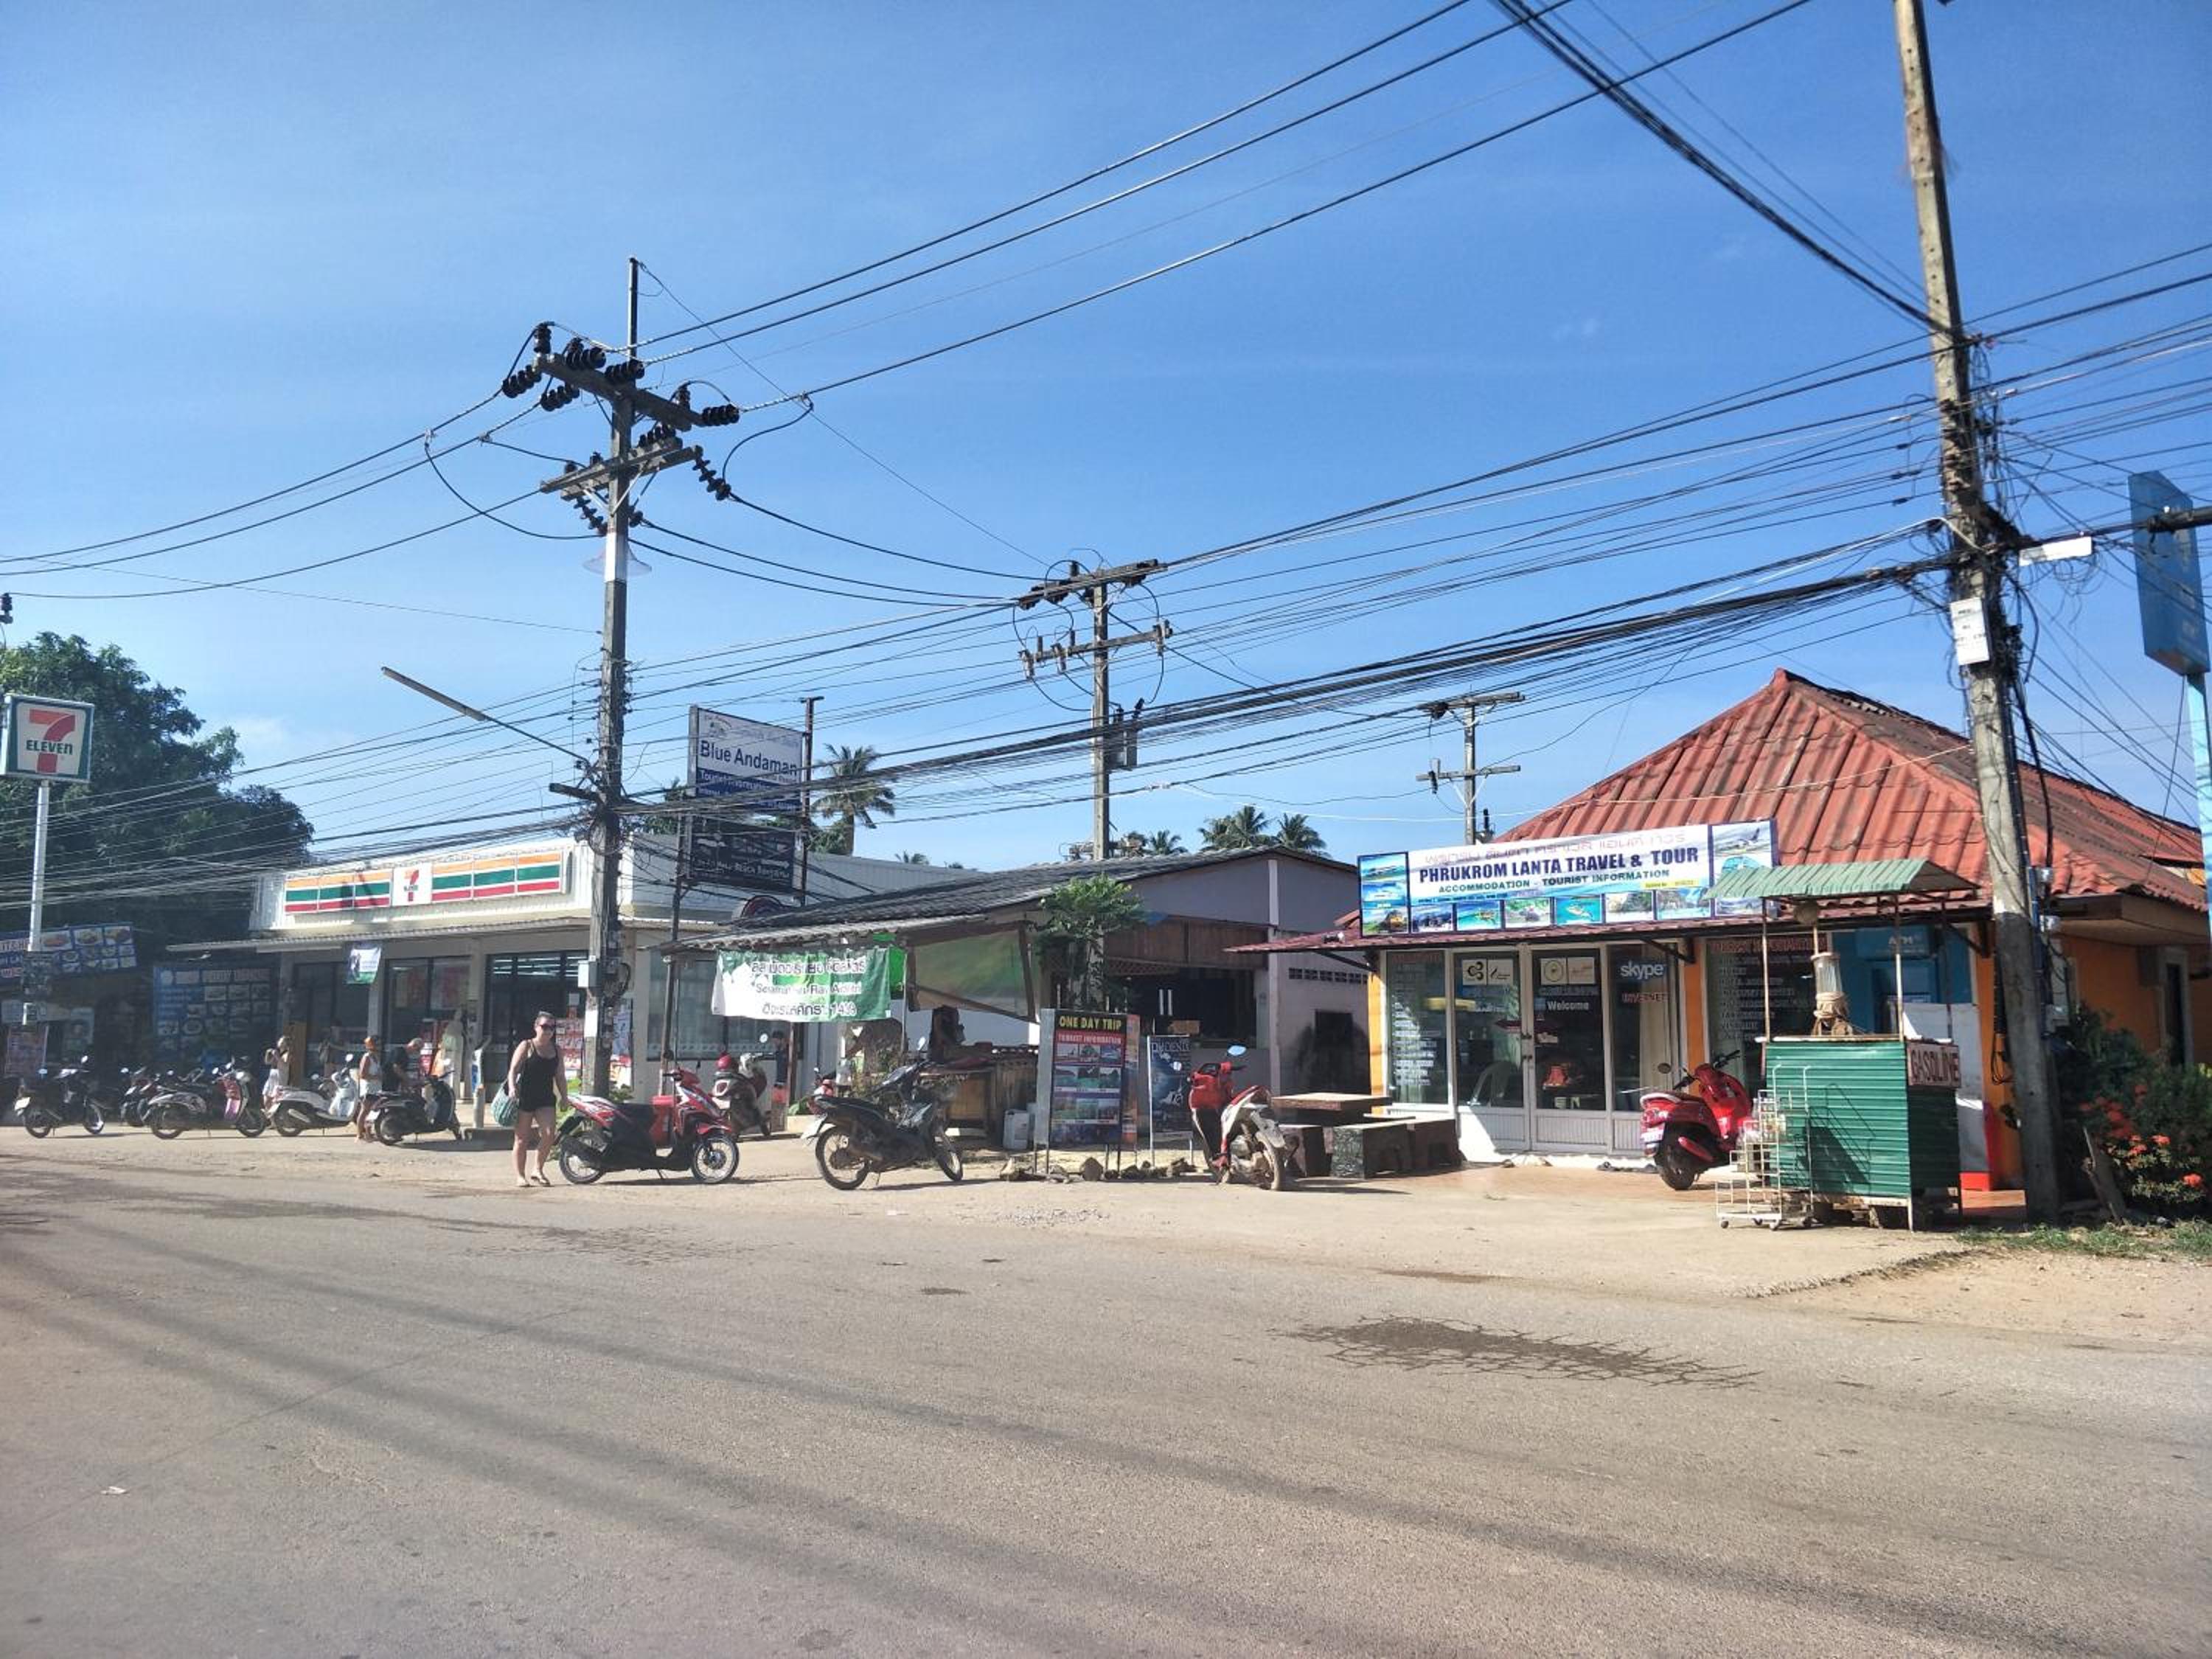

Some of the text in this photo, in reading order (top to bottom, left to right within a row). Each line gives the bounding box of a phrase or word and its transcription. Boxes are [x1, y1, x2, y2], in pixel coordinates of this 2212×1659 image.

[701, 740, 797, 776] Blue Andaman
[1419, 846, 1699, 883] PHRUKROM LANTA TRAVEL & TOUR
[1439, 879, 1530, 894] ACCOMMODATION
[1542, 874, 1588, 886] TOURIST
[1592, 869, 1670, 883] INFORMATION
[1620, 961, 1664, 980] skype
[1547, 1000, 1590, 1011] Welcome
[1059, 1015, 1121, 1031] ONE DAY TRIP
[1910, 1046, 1959, 1082] GASOLINE
